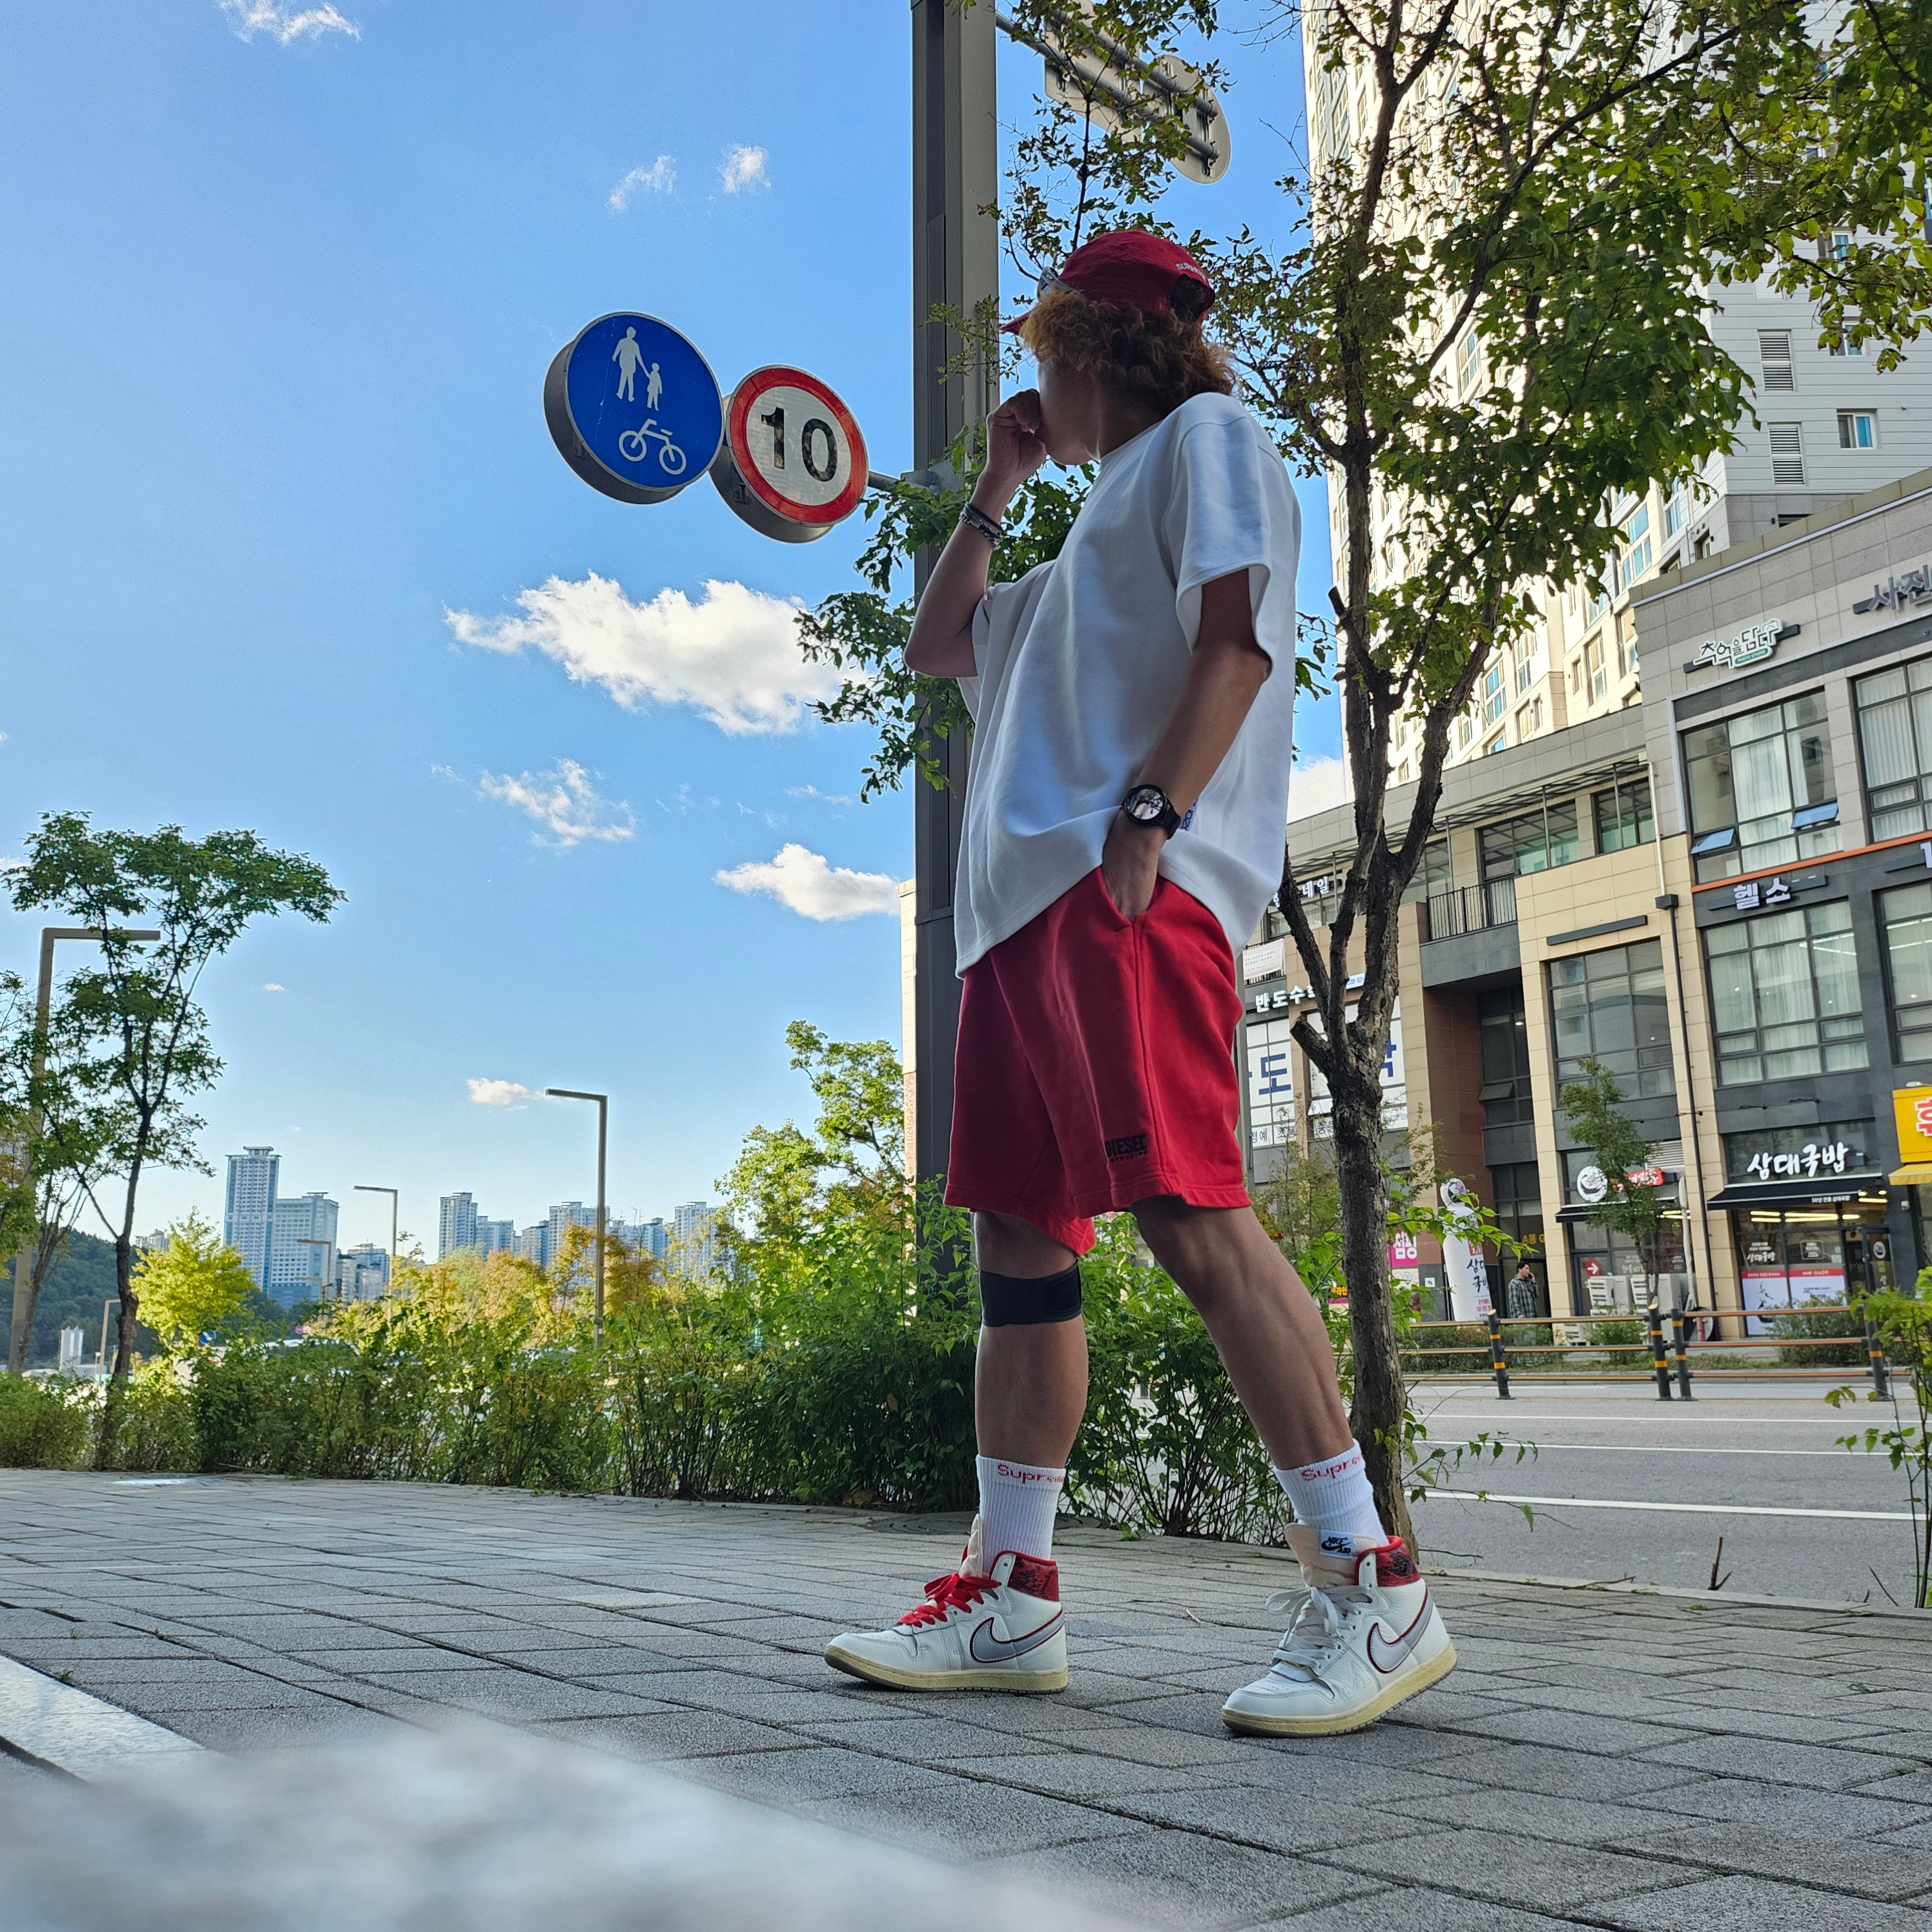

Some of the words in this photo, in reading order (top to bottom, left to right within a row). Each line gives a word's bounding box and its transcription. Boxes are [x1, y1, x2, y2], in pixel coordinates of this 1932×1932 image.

[761, 407, 838, 482] 10
[1867, 564, 1932, 611] 사진
[1737, 654, 1751, 663] PHOTO
[1751, 649, 1766, 659] STUDIO
[1104, 1133, 1147, 1158] DIESEL
[1747, 1141, 1849, 1180] 삼대국밥
[1326, 1536, 1345, 1545] NIKE
